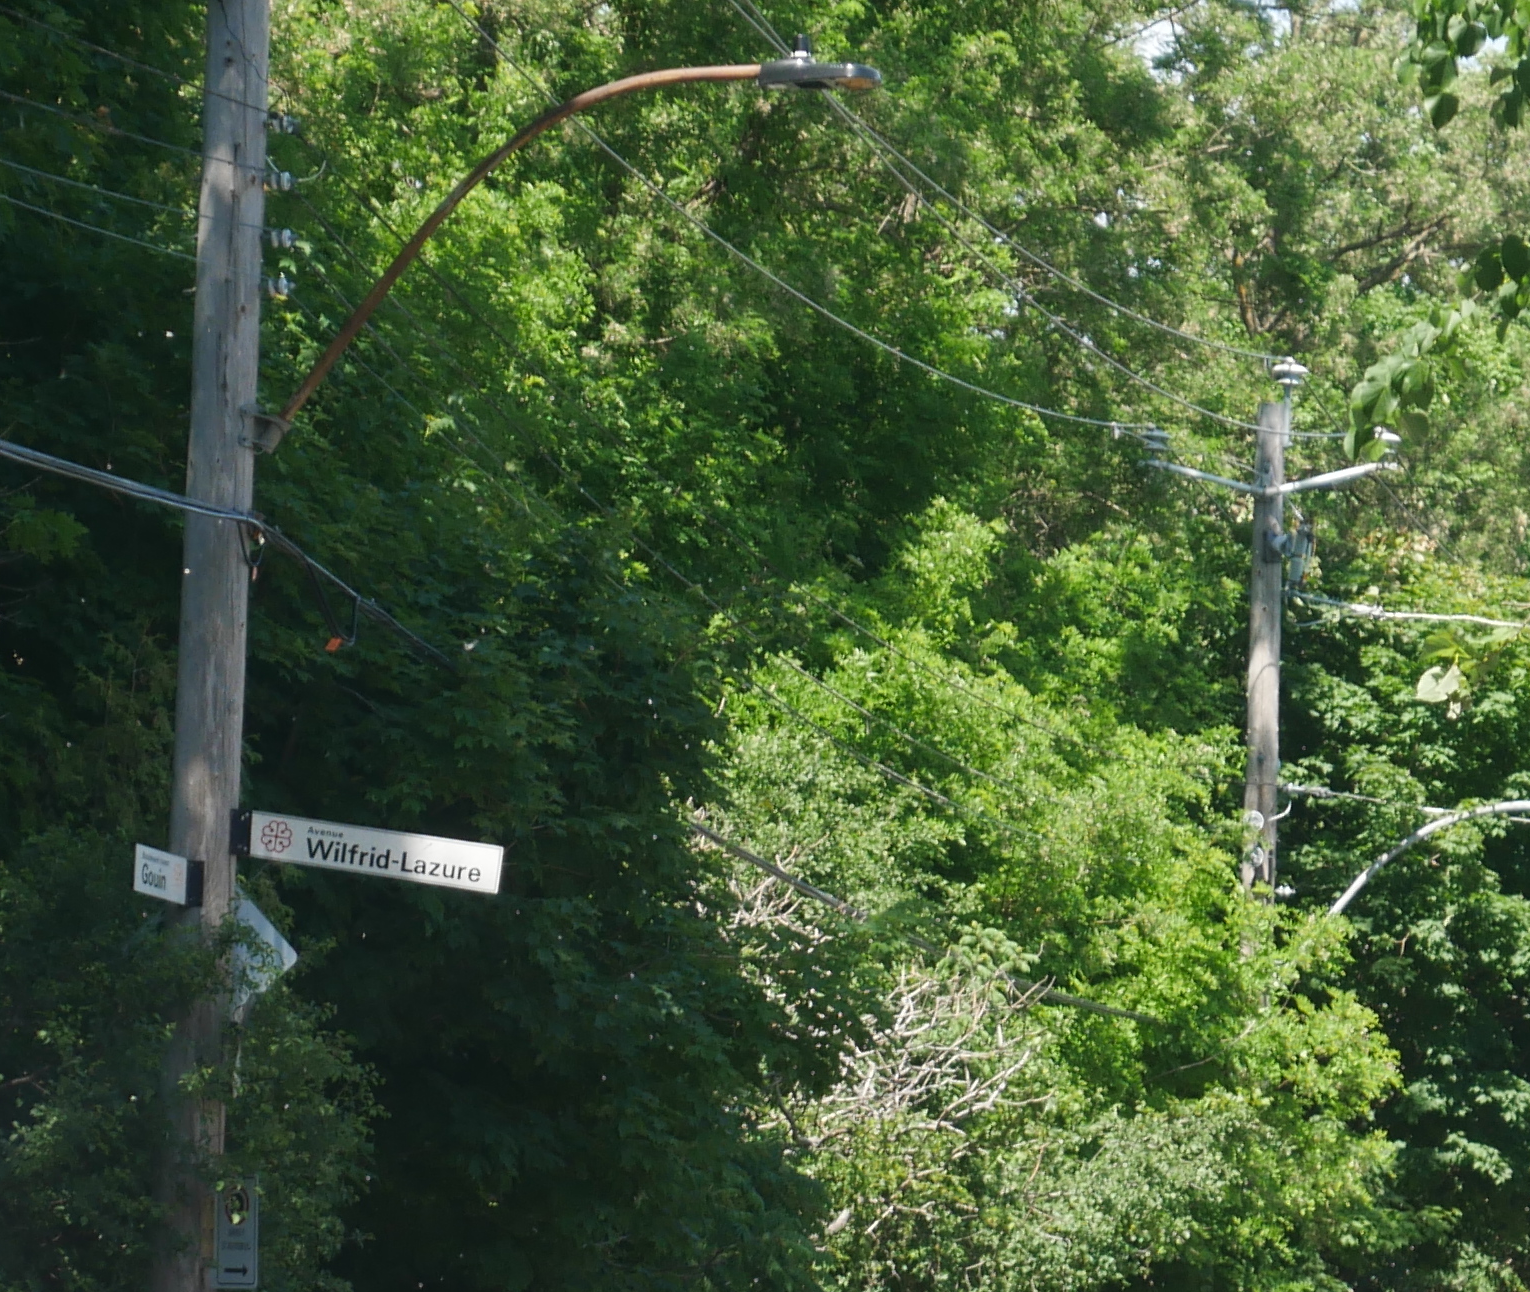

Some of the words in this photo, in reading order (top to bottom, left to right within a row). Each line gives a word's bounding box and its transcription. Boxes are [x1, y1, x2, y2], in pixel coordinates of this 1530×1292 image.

[307, 825, 345, 839] Avenue
[306, 837, 482, 883] Wilfrid-Lazure
[141, 862, 167, 890] Gouin
